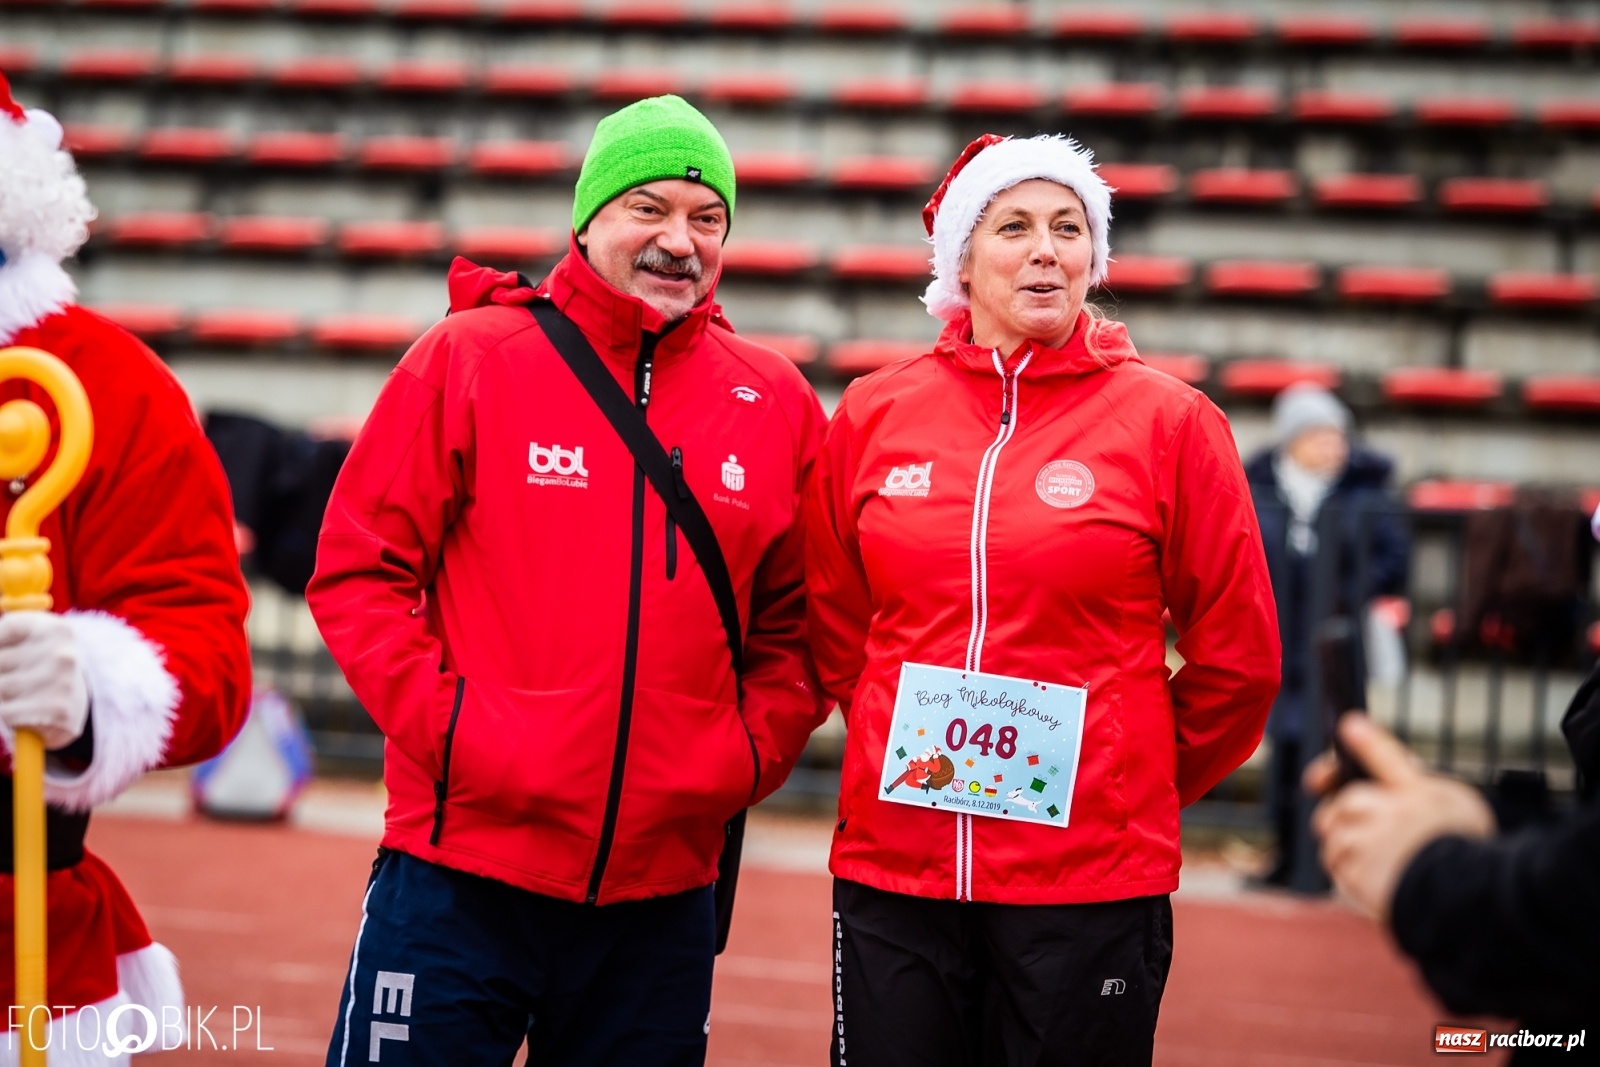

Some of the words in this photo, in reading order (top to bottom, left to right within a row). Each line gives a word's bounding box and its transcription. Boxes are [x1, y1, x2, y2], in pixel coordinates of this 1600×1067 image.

[528, 441, 589, 478] bbl
[884, 461, 933, 489] bbl
[1047, 485, 1082, 497] SPORT
[914, 689, 953, 709] Bieg
[945, 717, 1019, 760] 048
[943, 794, 971, 807] Racibórz,
[971, 799, 1001, 811] 8.12.2019
